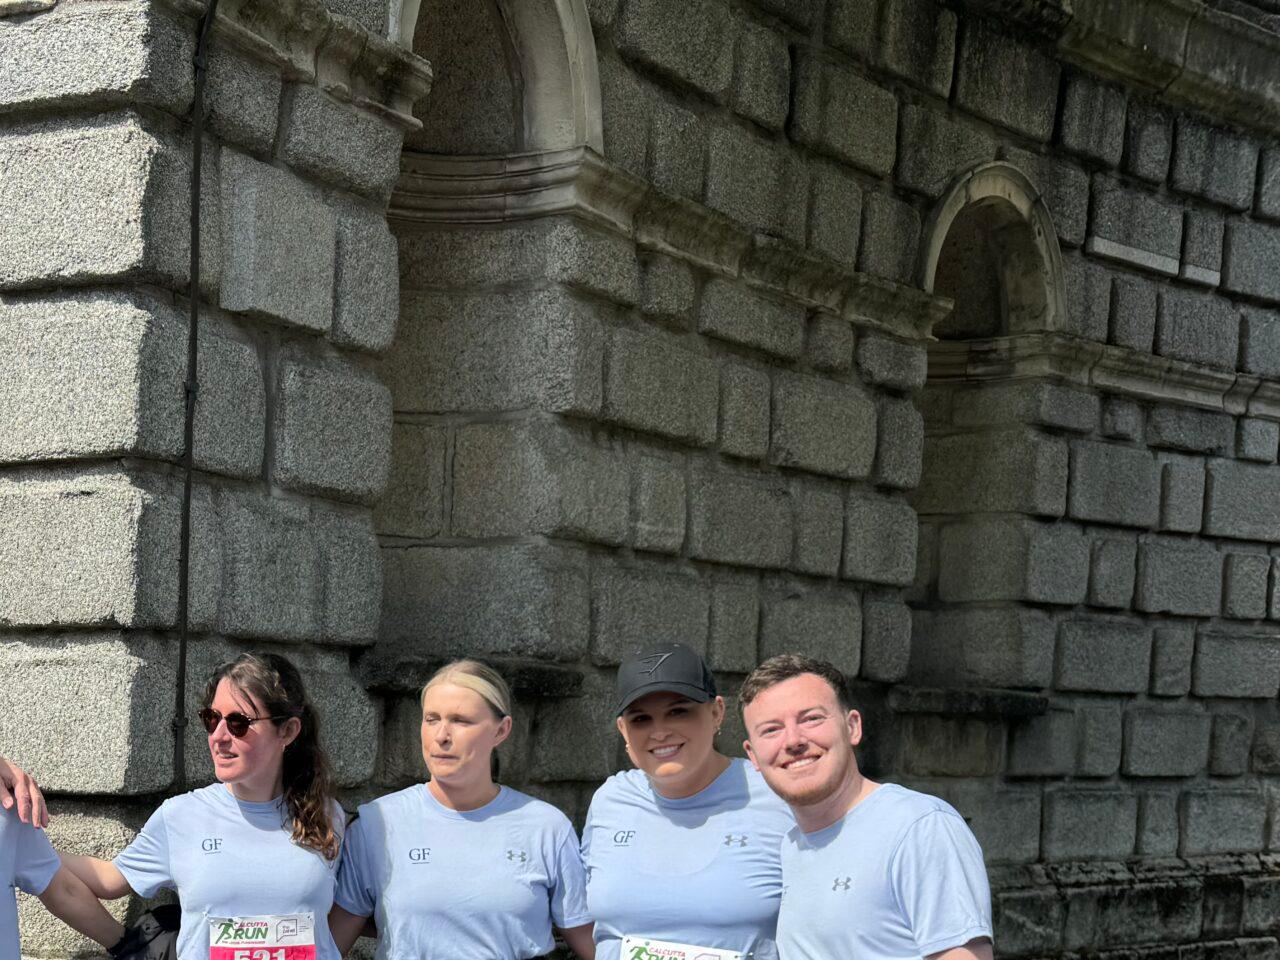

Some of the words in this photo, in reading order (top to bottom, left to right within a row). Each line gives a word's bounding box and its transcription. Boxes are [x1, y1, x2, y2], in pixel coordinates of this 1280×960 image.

[613, 830, 636, 844] GF
[202, 838, 222, 851] GF
[409, 848, 431, 861] GF
[233, 928, 268, 940] RUN
[649, 947, 685, 957] CALCUTTA
